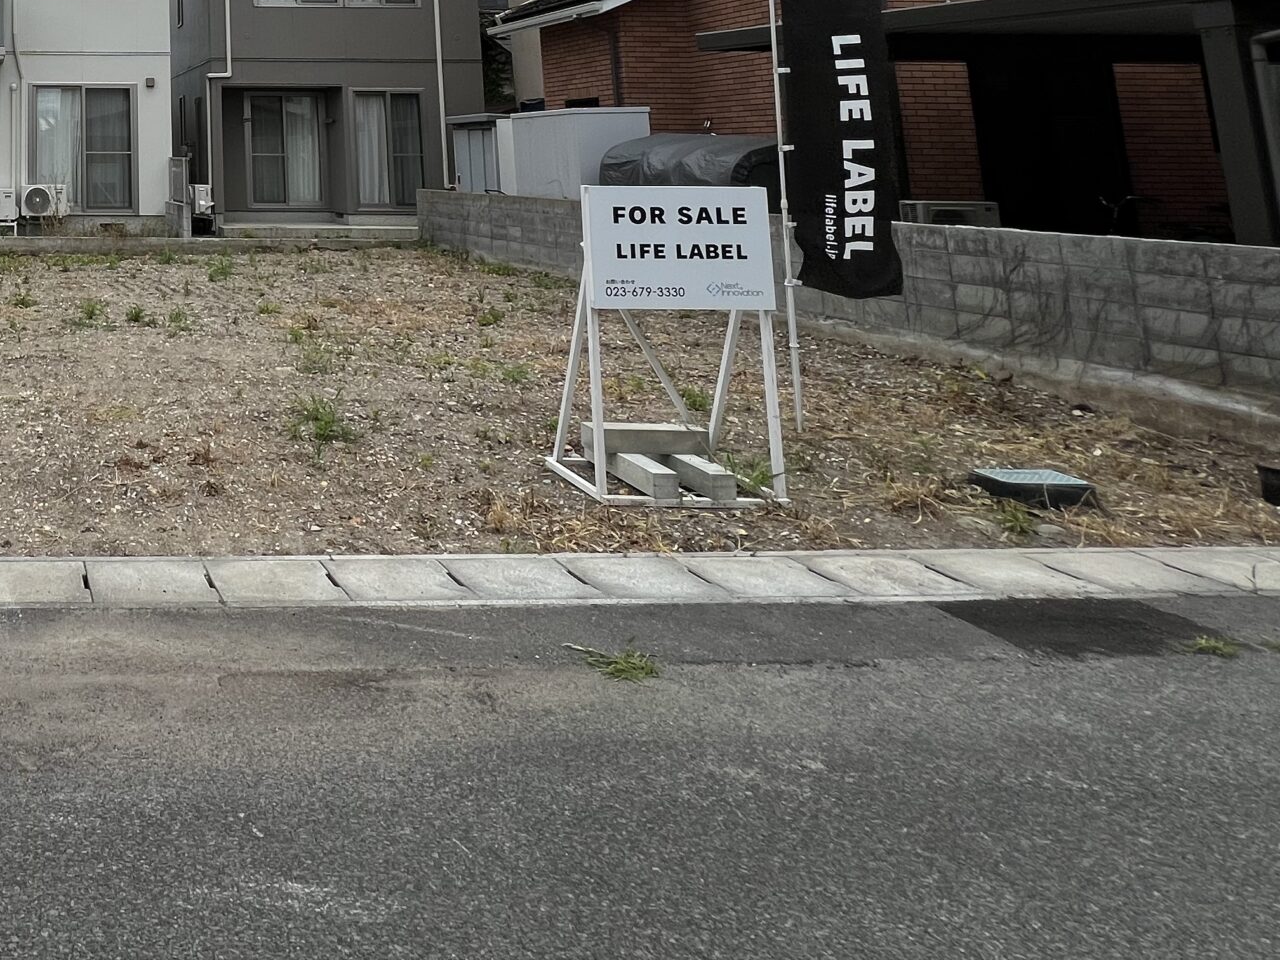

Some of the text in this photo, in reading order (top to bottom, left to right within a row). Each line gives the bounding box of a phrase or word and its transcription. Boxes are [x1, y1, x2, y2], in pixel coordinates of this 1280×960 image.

[831, 34, 875, 259] LIFE LABEL
[612, 206, 747, 225] FOR SALE
[825, 194, 837, 260] lifelabel.jp
[616, 243, 748, 260] LIFE LABEL
[605, 286, 685, 297] 023-679-3330
